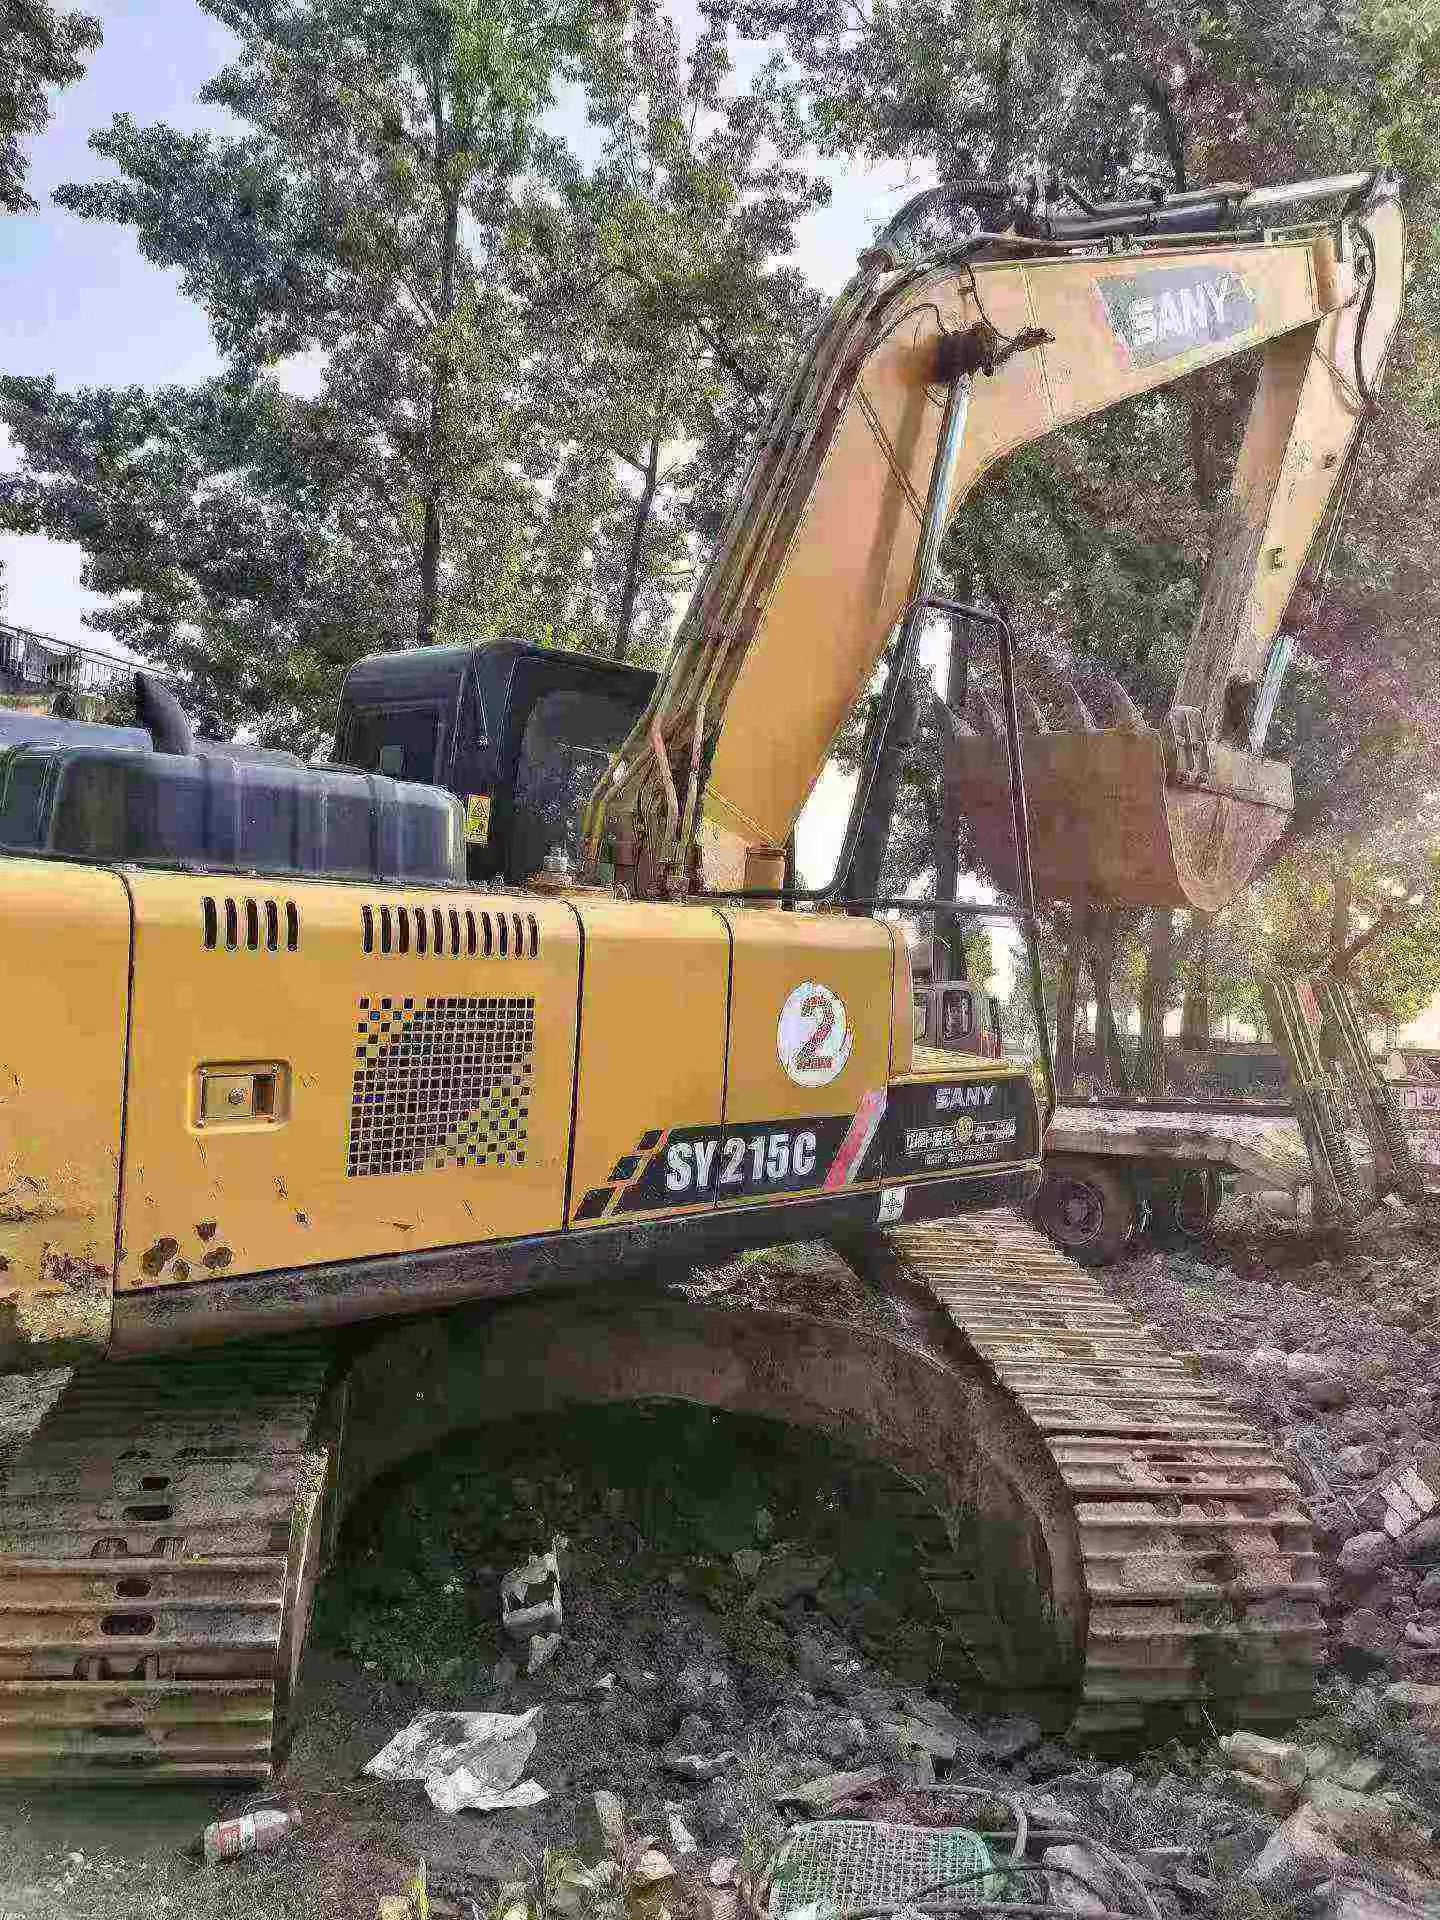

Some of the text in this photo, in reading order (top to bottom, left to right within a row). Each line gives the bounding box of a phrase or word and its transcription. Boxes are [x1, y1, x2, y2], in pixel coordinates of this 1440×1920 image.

[1130, 276, 1231, 345] SANY
[796, 993, 835, 1071] 2
[935, 1085, 994, 1108] SANY
[665, 1130, 817, 1192] SY215C
